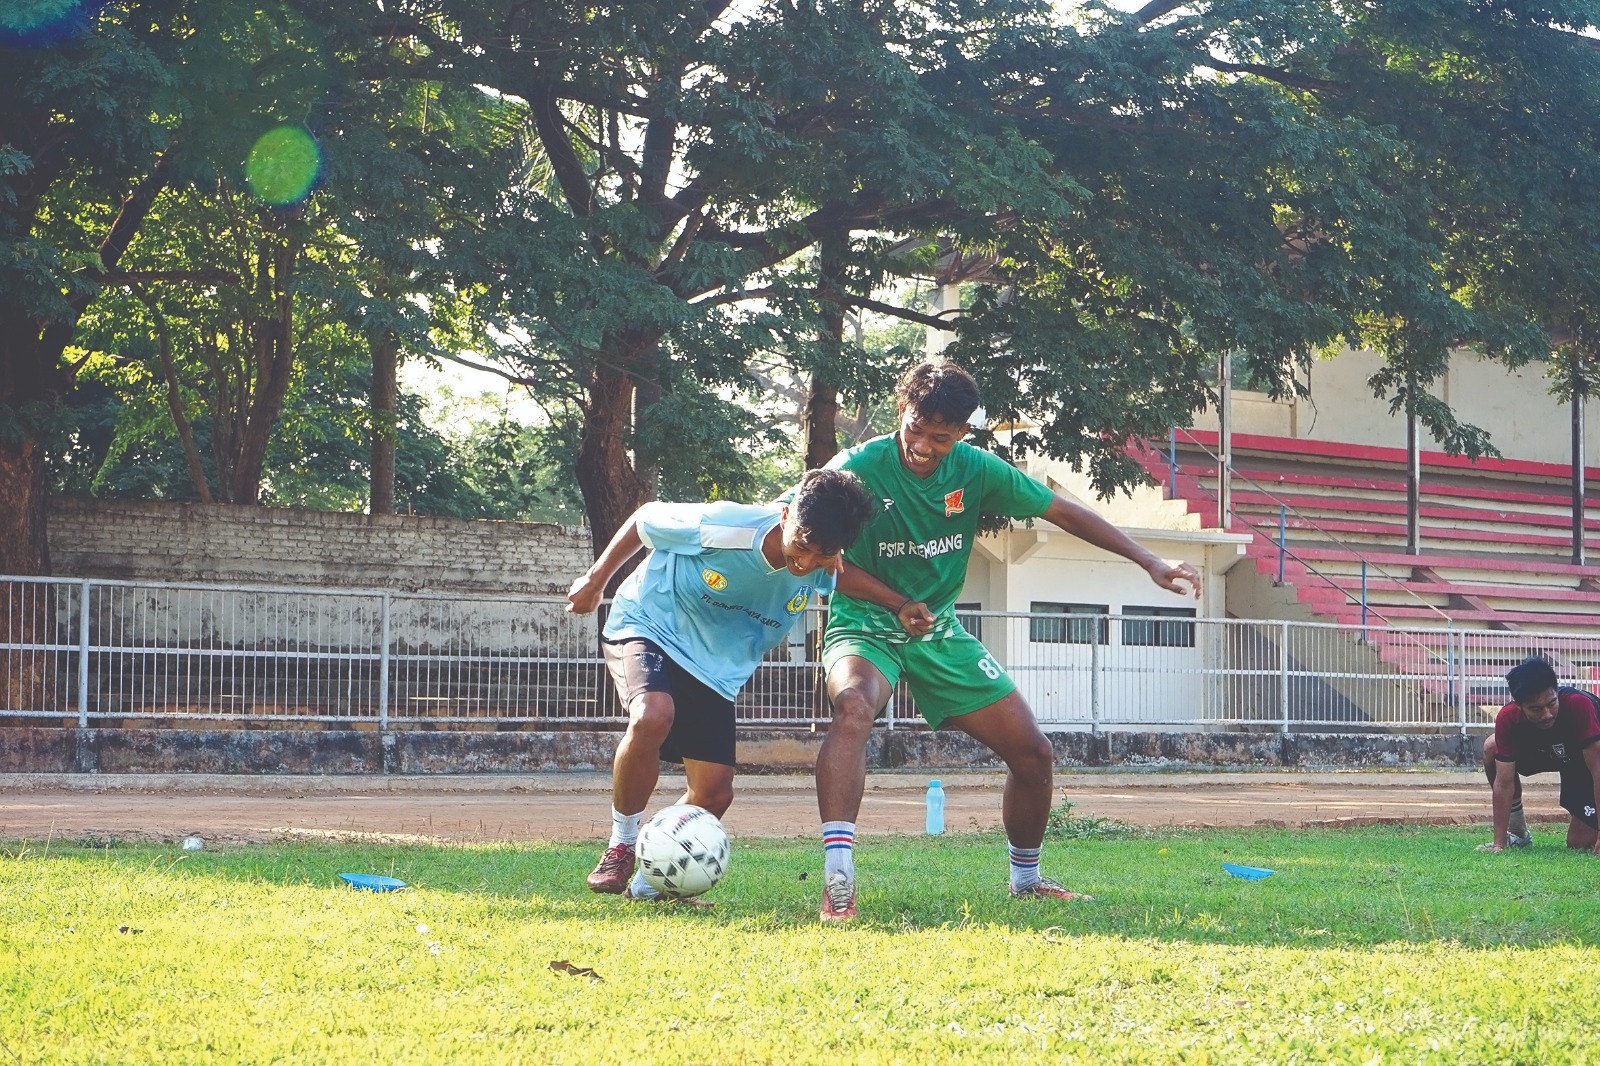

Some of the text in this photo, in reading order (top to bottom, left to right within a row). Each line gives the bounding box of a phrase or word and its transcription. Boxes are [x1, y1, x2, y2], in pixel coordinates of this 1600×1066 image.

[879, 534, 962, 559] PSIR REMBANG
[760, 617, 782, 629] SAKTI
